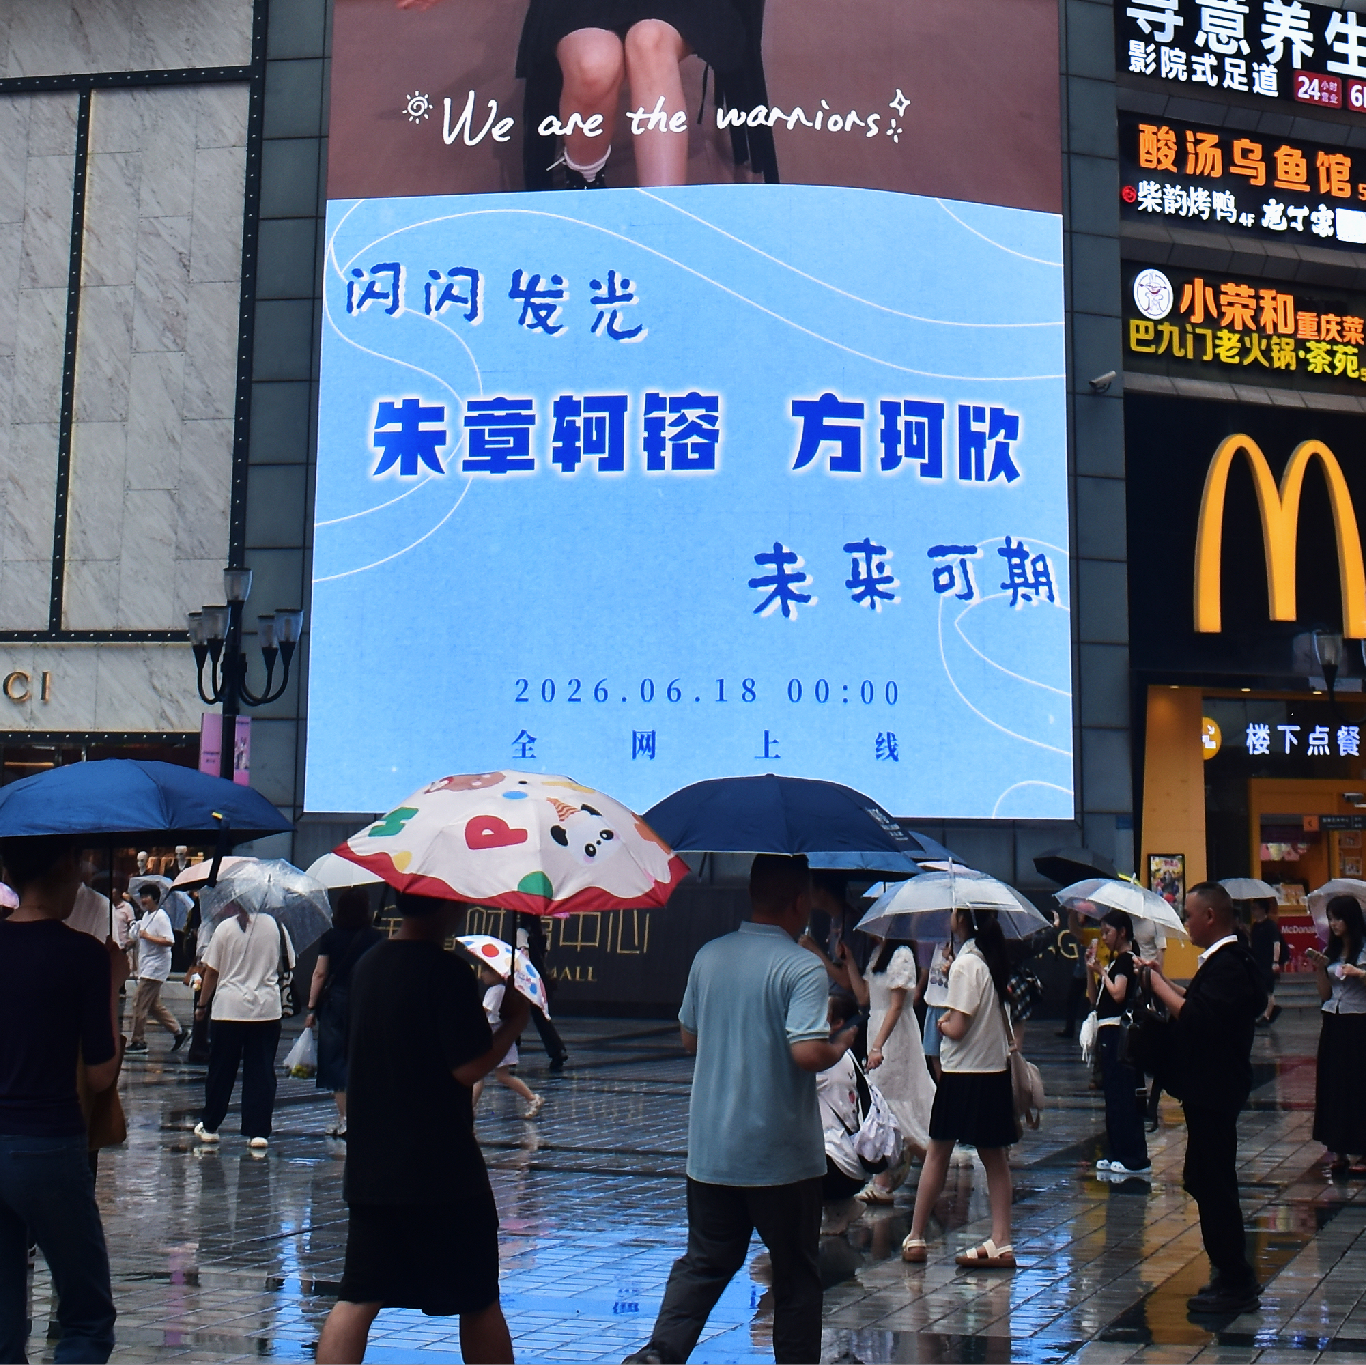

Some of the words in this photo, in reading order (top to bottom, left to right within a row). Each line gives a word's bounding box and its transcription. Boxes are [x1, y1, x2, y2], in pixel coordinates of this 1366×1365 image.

[1128, 40, 1279, 98] 影院式足道
[1297, 75, 1321, 101] 24
[441, 89, 512, 147] We
[538, 113, 605, 138] are
[626, 95, 688, 136] the
[716, 99, 881, 138] warriors
[1138, 123, 1352, 198] 酸汤乌鱼馆
[1239, 212, 1255, 227] 4F
[345, 261, 647, 343] 闪闪发光
[1180, 277, 1296, 335] 小荣和
[1296, 310, 1365, 346] 重庆菜
[372, 391, 720, 476] 朱章轲镕
[791, 392, 1022, 484] 方珂欣
[748, 536, 1056, 620] 未来可期
[515, 677, 757, 706] 2026.06.18
[787, 679, 899, 706] 00:00
[511, 729, 900, 762] 全网上线
[1246, 723, 1361, 757] 楼下点餐
